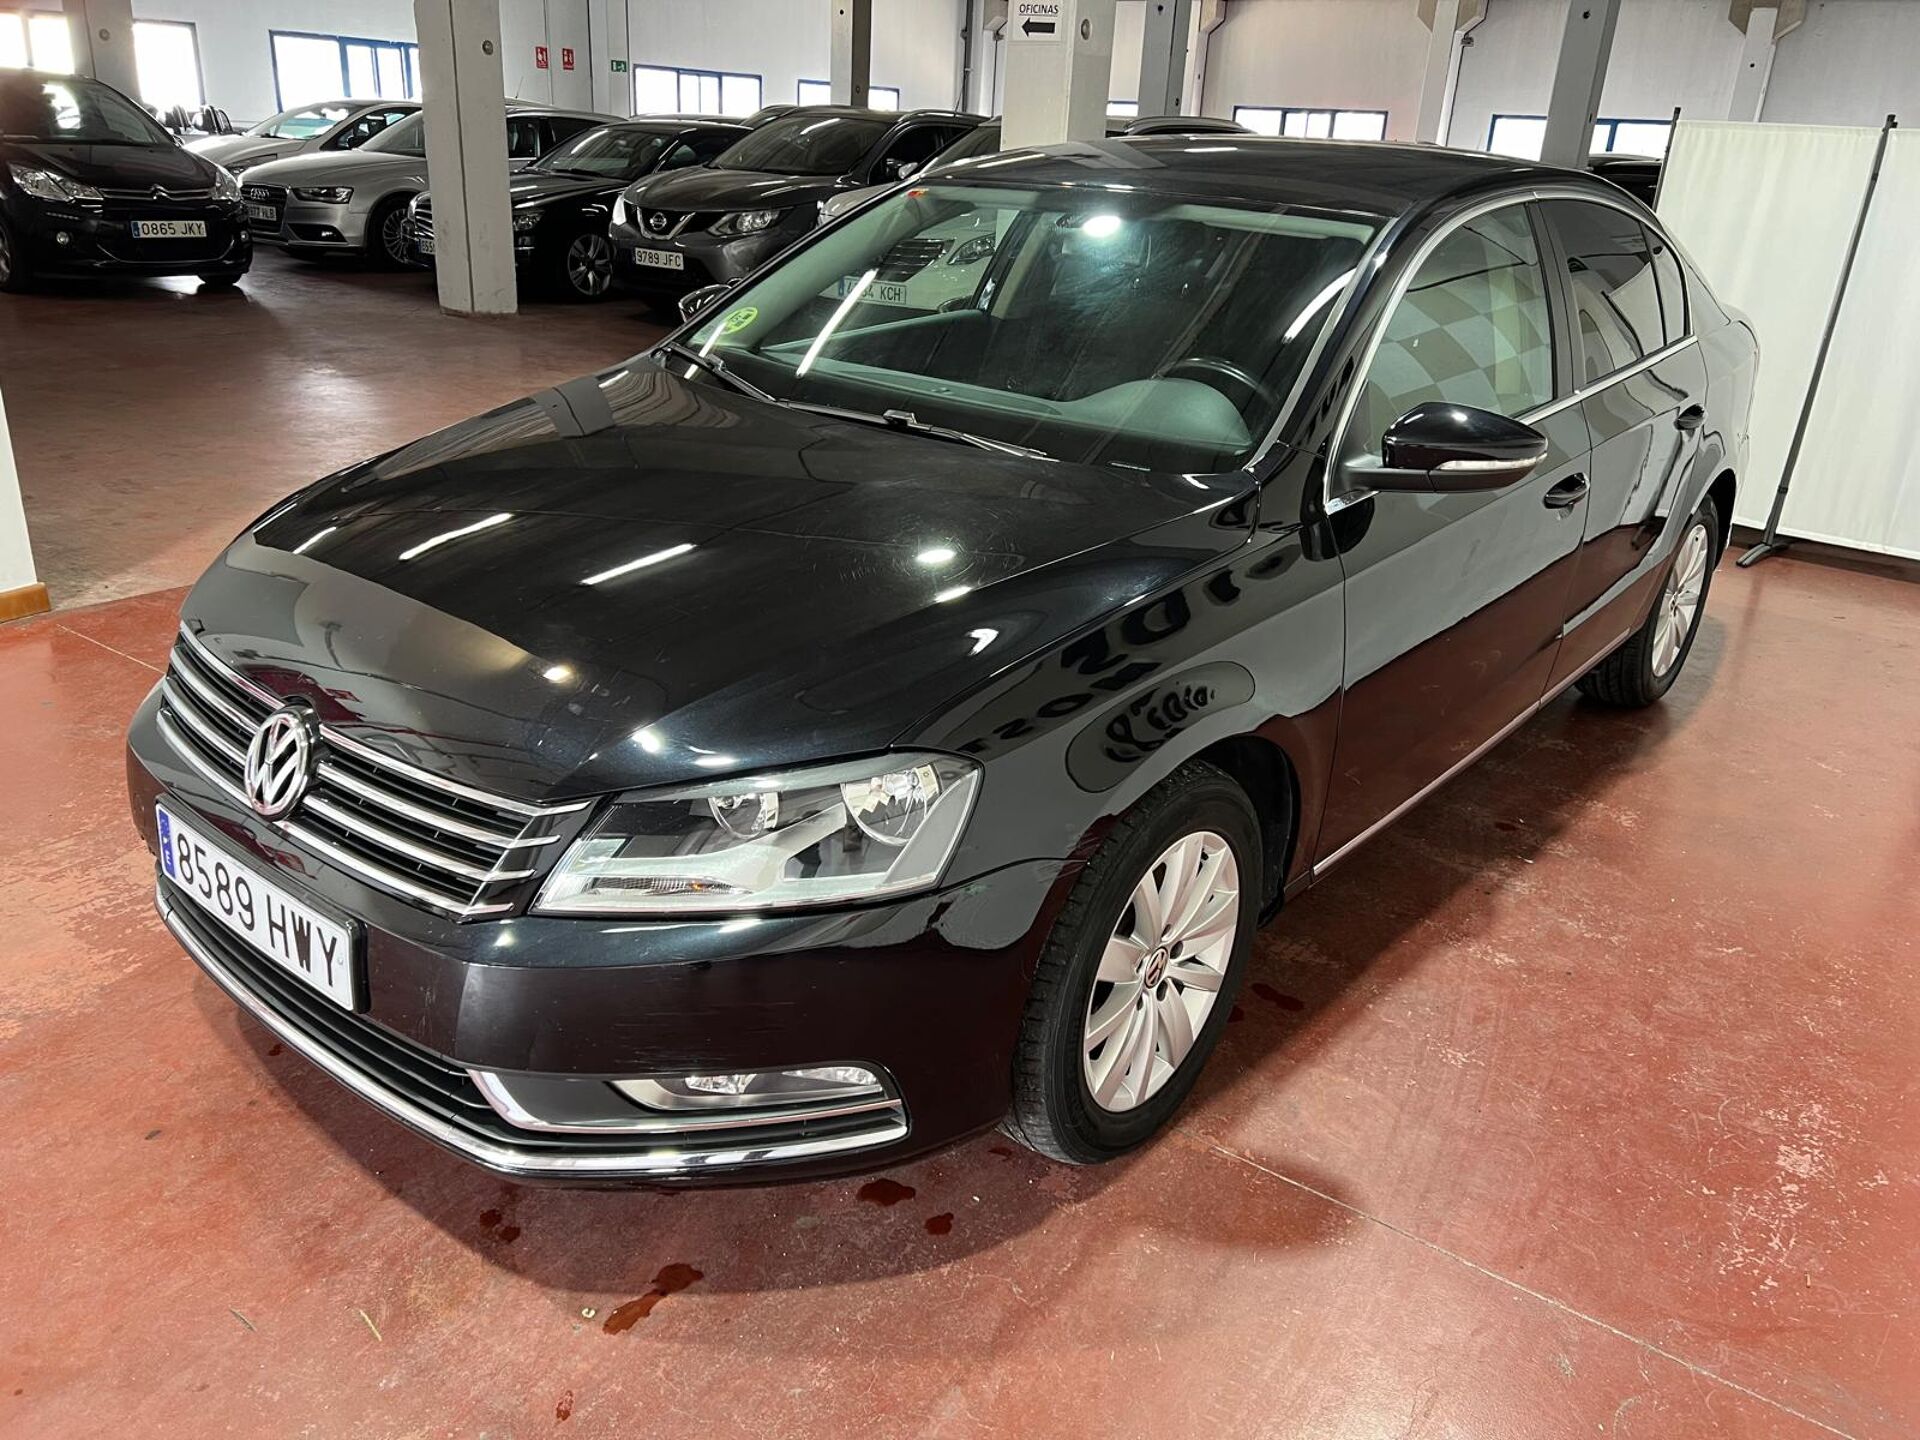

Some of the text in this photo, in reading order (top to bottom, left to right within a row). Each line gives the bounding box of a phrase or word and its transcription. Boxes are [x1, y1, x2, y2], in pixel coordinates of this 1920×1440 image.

[1019, 4, 1059, 14] OFICINAS
[142, 223, 203, 235] 0865 JKY
[636, 250, 681, 267] 9789 JFC
[880, 285, 901, 301] KCH
[177, 833, 338, 987] 8589 HWY
